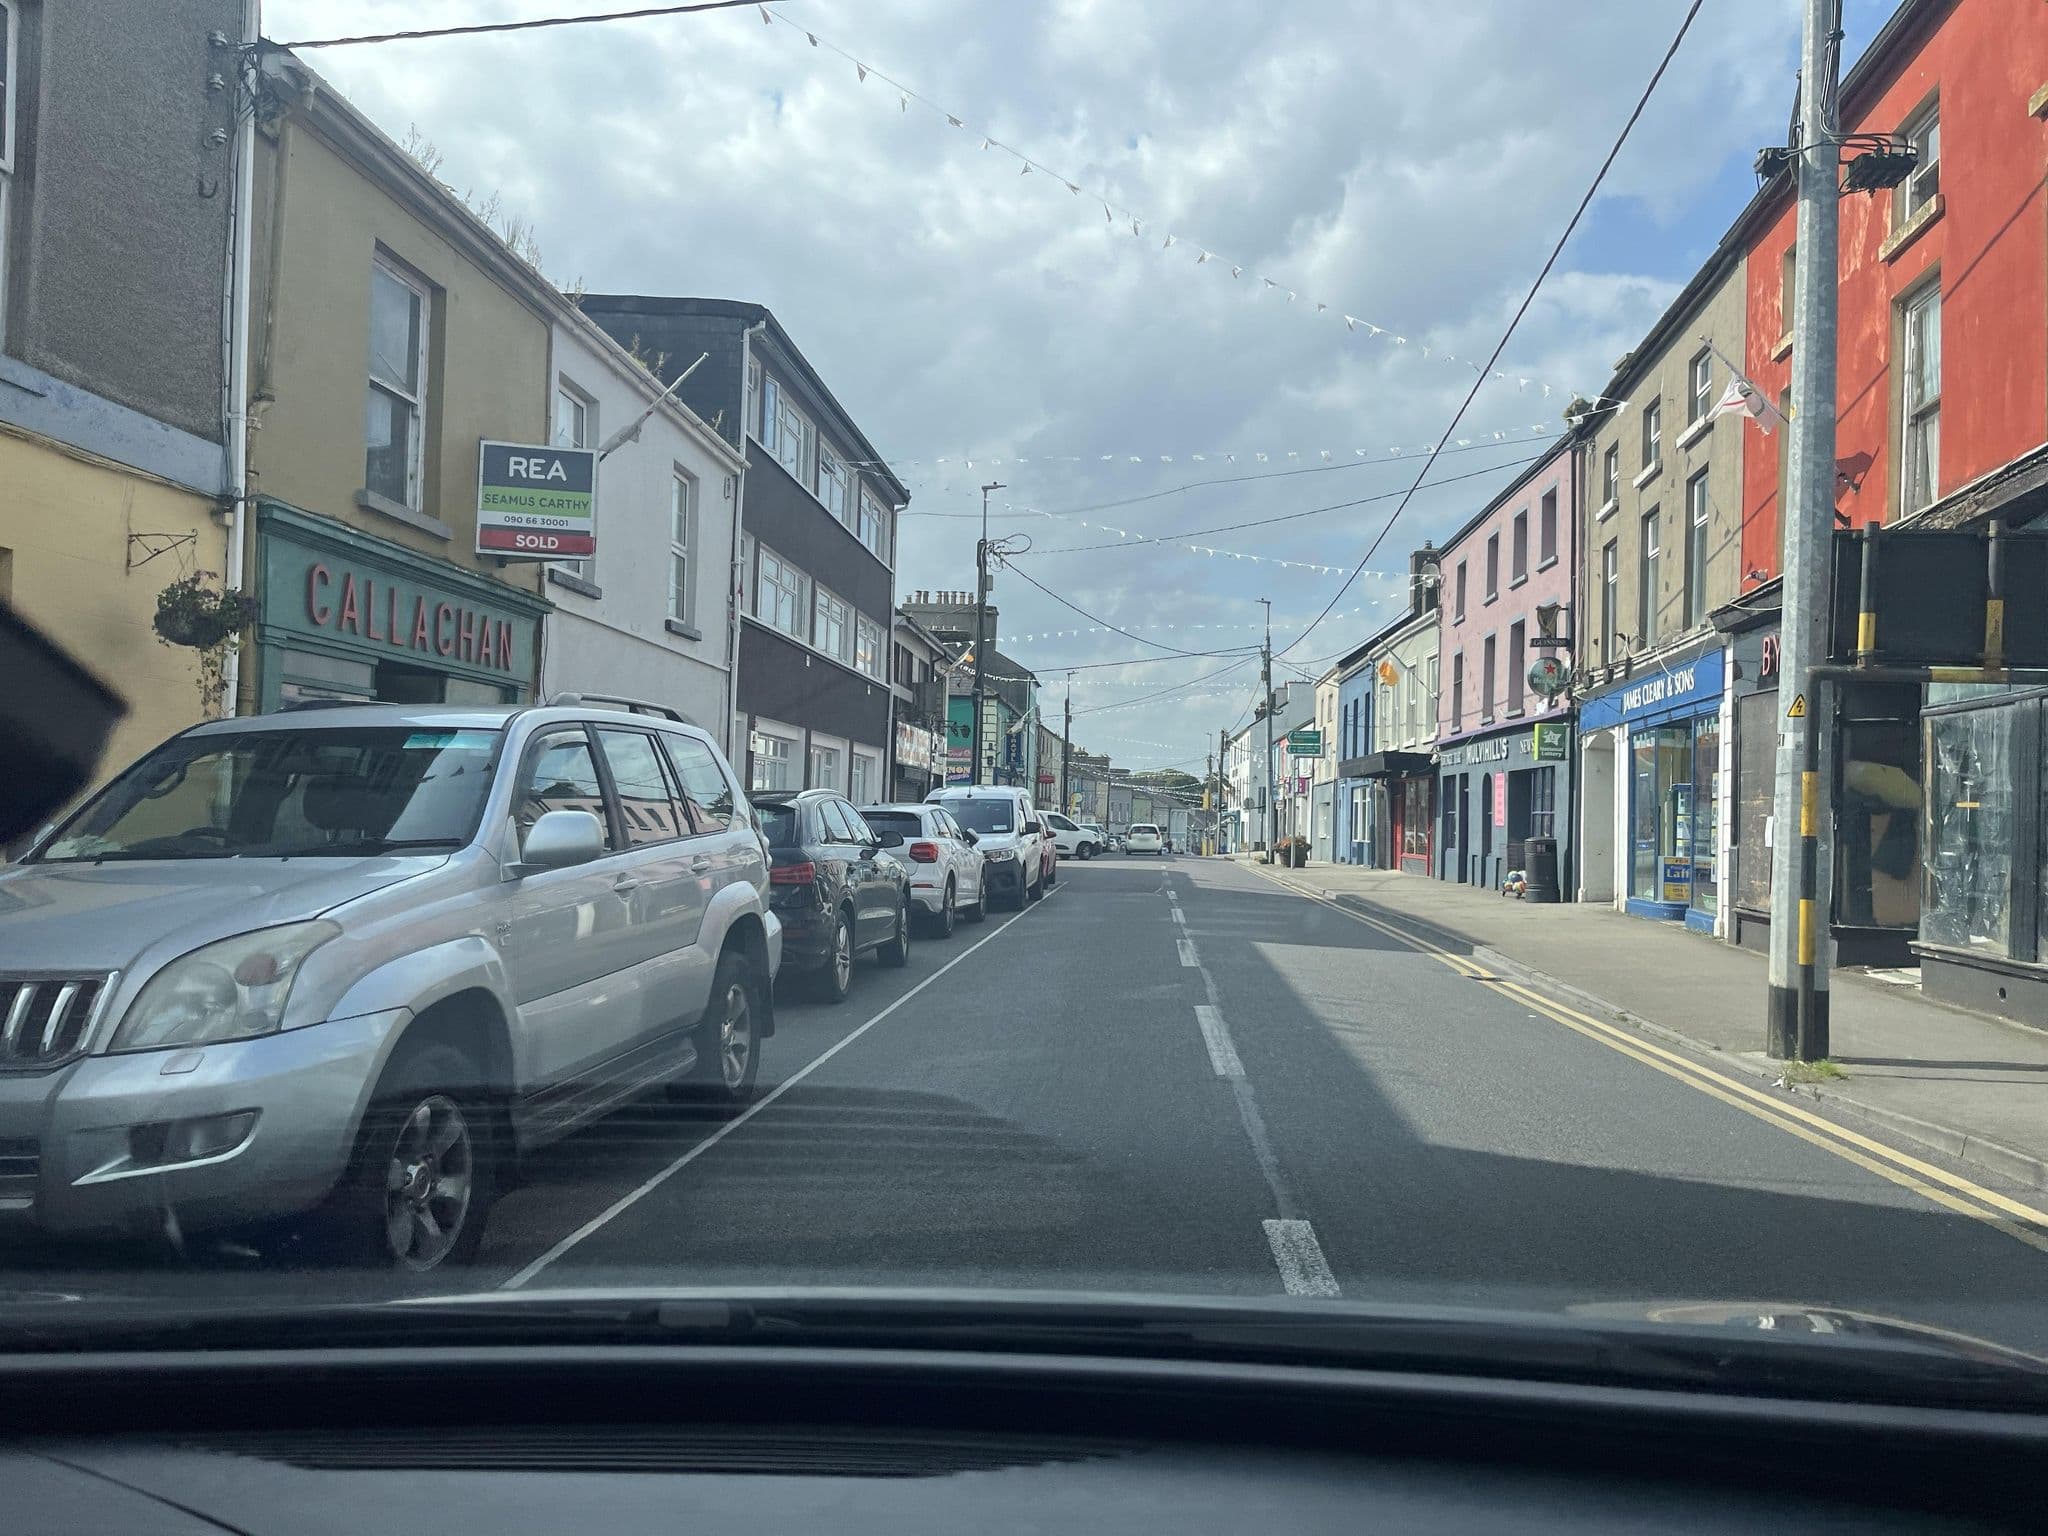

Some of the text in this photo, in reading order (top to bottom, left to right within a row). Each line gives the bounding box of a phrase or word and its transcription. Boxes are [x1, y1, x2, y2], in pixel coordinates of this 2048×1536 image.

[508, 456, 567, 482] REA
[483, 493, 590, 510] SEAMUS CARTHY
[504, 515, 569, 527] 090 66 30001
[515, 534, 559, 549] SOLD
[1623, 667, 1695, 715] JAMES CLEARY & SONS
